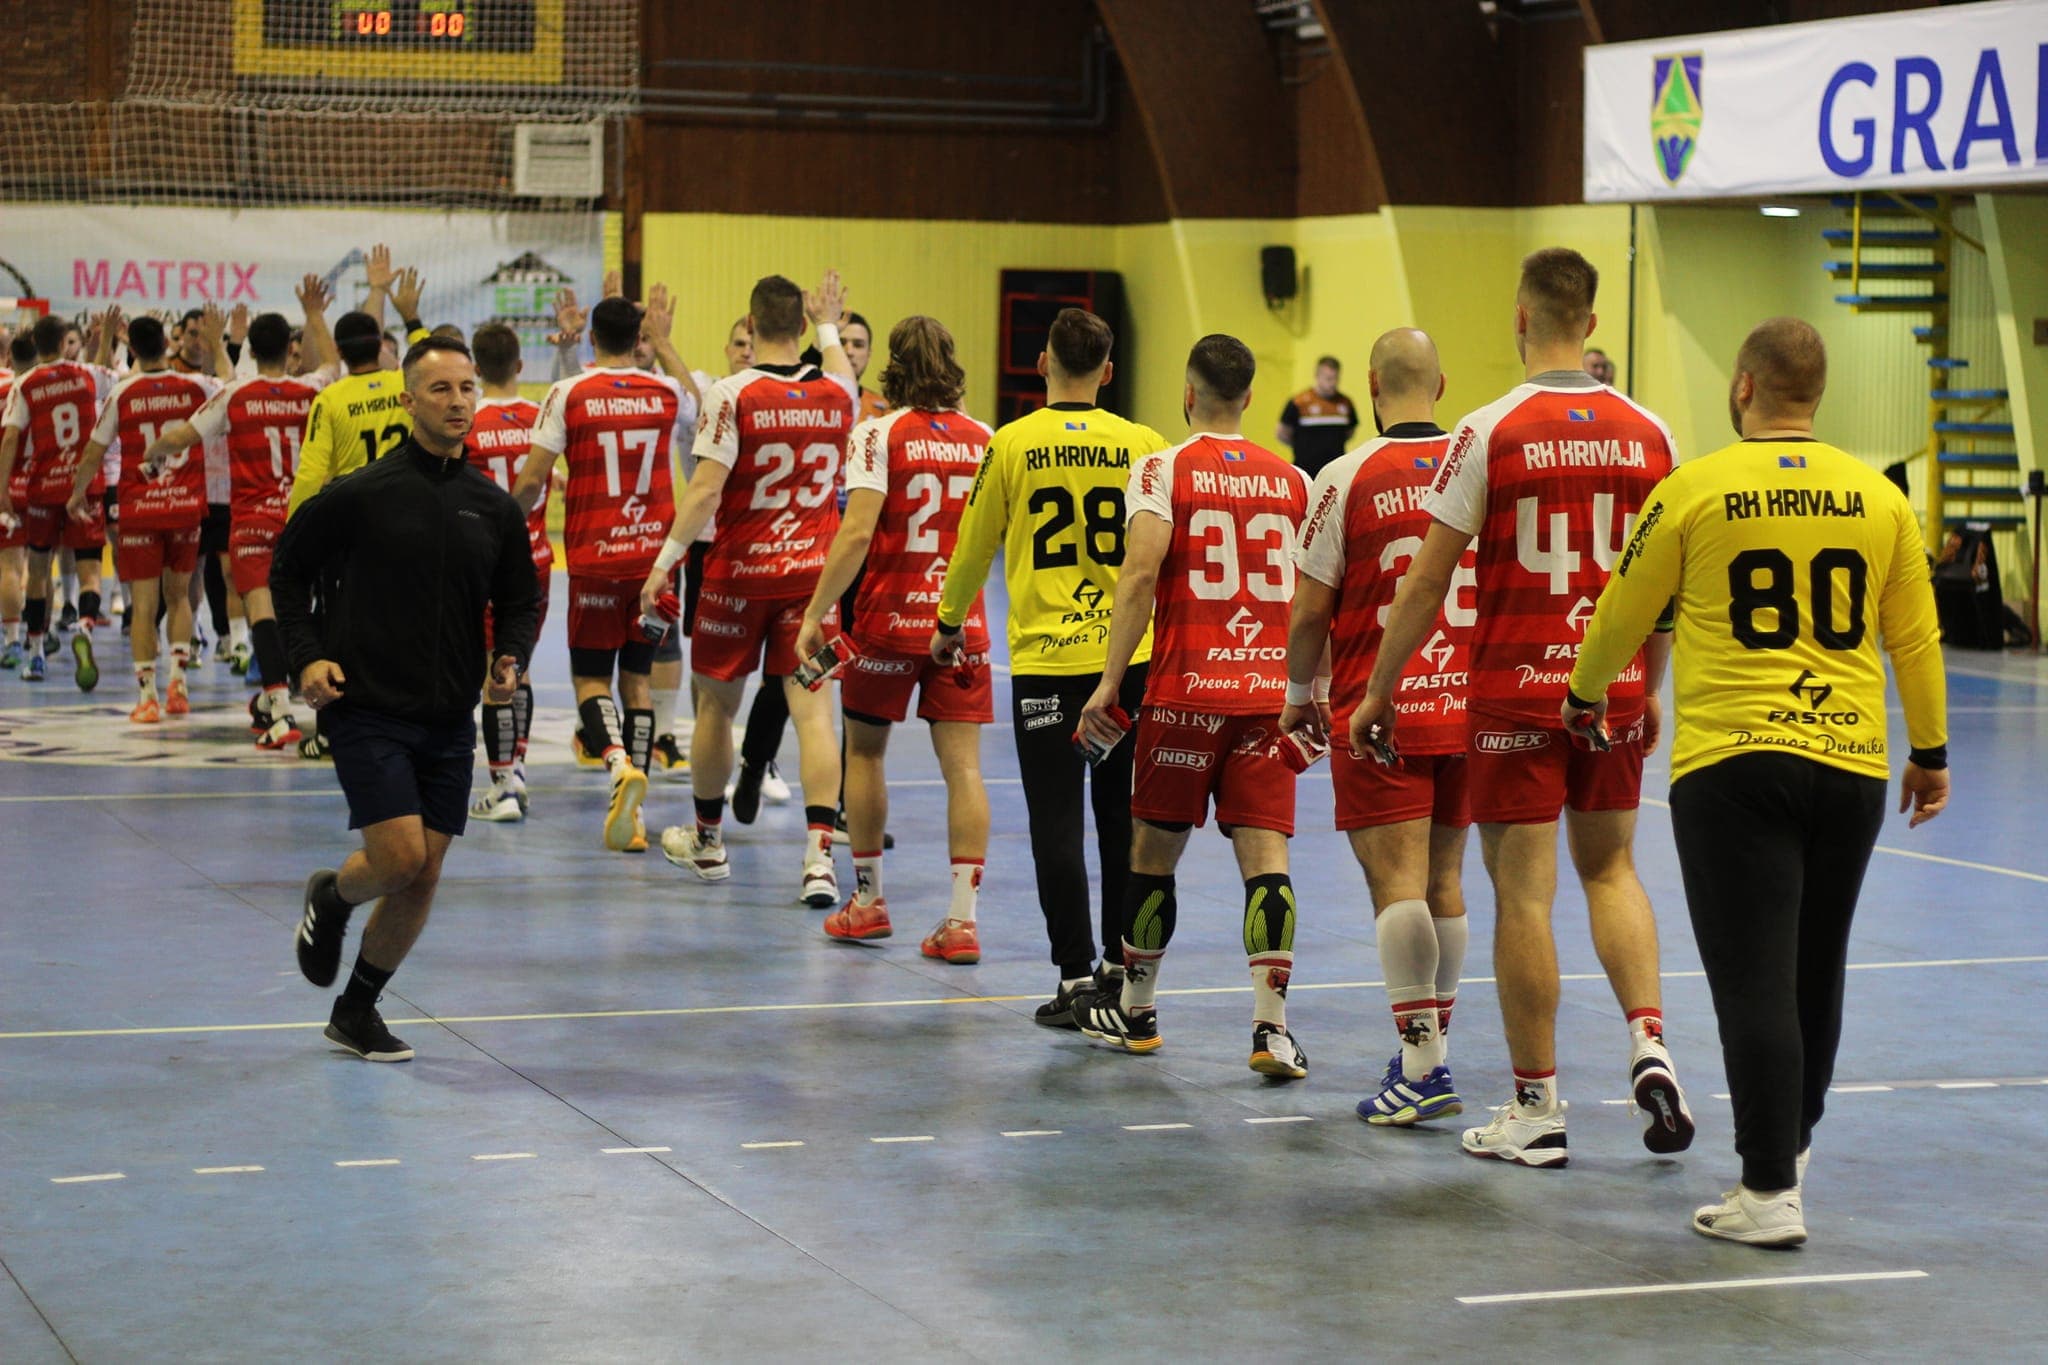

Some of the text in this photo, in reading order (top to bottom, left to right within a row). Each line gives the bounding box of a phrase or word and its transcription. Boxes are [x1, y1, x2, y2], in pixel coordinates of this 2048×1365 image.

[72, 259, 259, 301] MATRIX
[52, 402, 80, 449] 8
[498, 428, 529, 447] KRIV
[264, 426, 302, 478] 11
[597, 428, 661, 497] 17
[1434, 425, 1475, 495] RESTORAN
[750, 442, 840, 510] 23
[610, 521, 663, 538] FASTCO
[1028, 486, 1126, 570] 28
[1189, 508, 1296, 601] 33
[1516, 492, 1638, 595] 44
[781, 553, 826, 576] Putnik
[906, 591, 942, 603] FAS
[1727, 547, 1868, 651] 80
[888, 612, 935, 630] Prevoz
[1039, 634, 1088, 653] Prevoz
[1206, 647, 1287, 661] FASTCO
[857, 657, 906, 673] INDEX
[1515, 664, 1570, 688] Prevo
[1183, 672, 1287, 694] Prevoz Putn
[1027, 713, 1058, 728] INDEX
[1767, 710, 1859, 726] FASTCO
[1482, 734, 1543, 750] INDEX
[1157, 750, 1209, 768] INDEX
